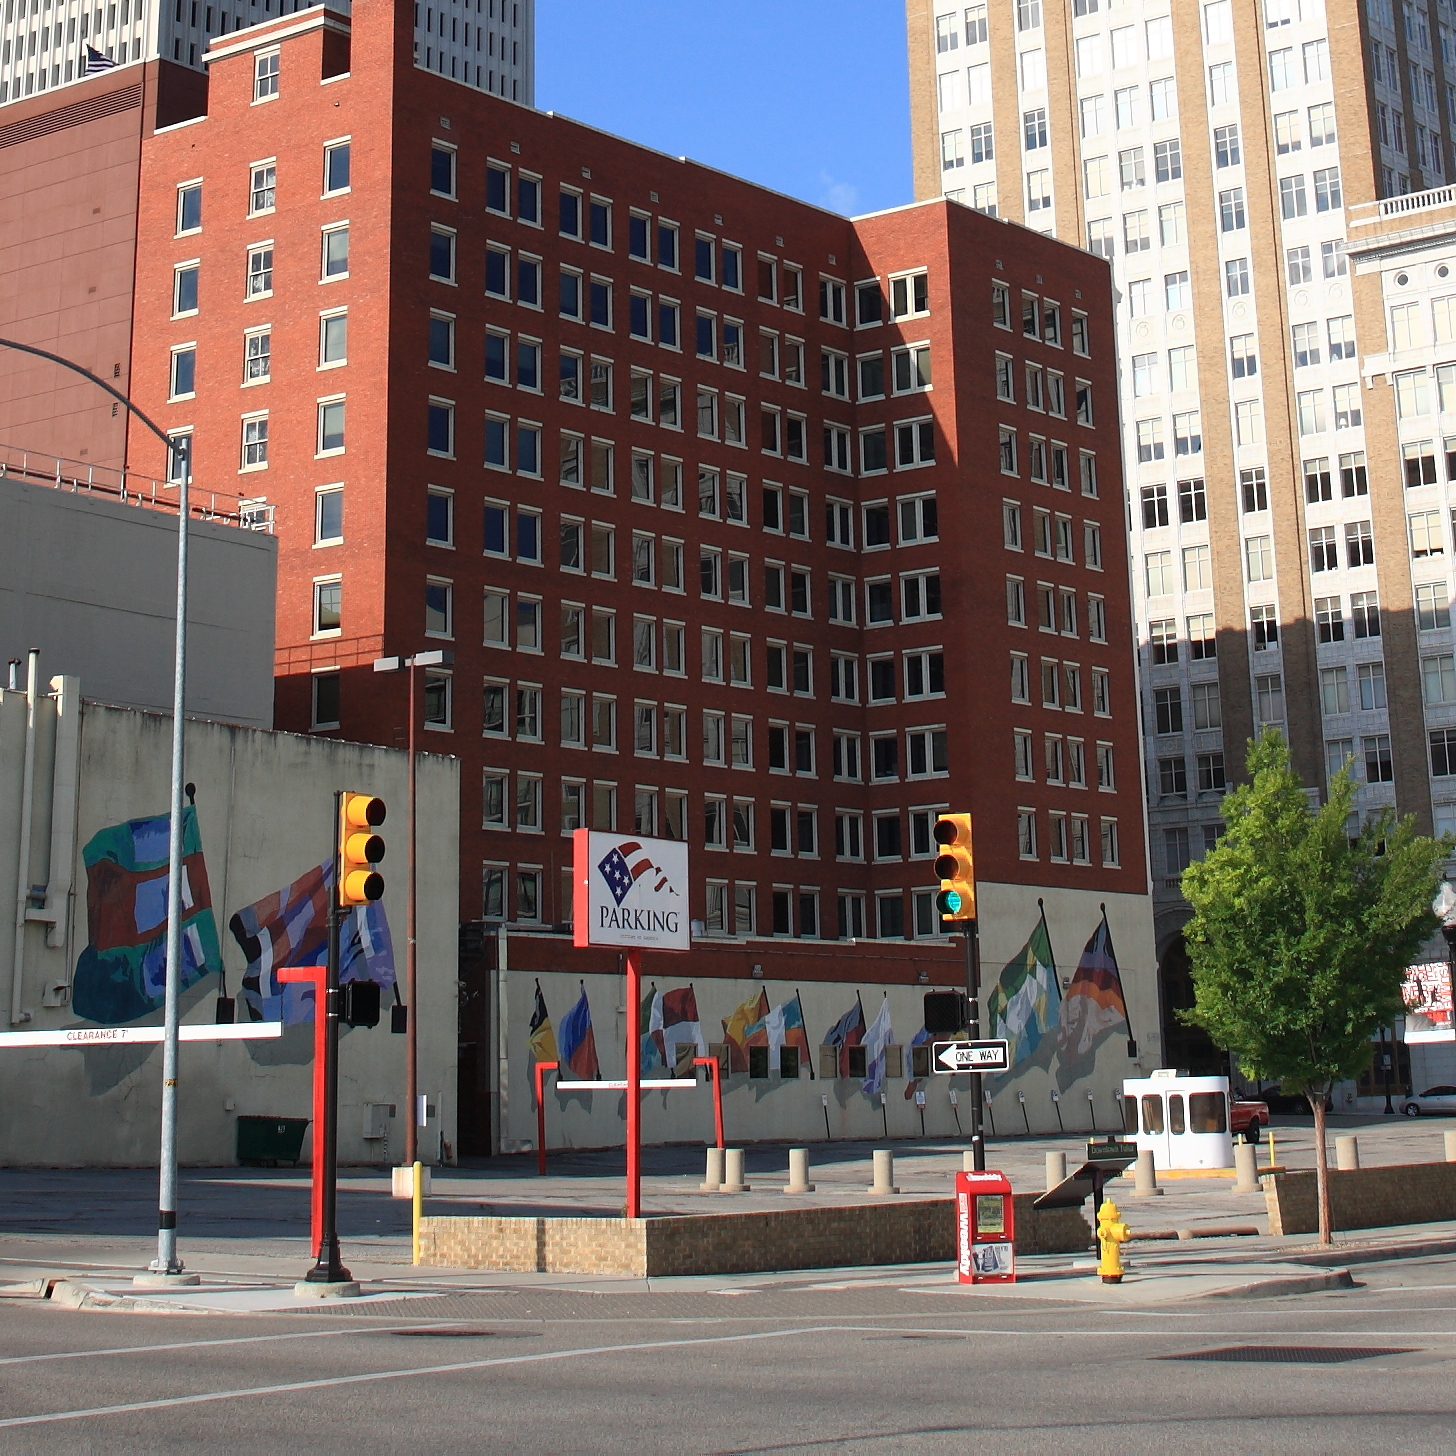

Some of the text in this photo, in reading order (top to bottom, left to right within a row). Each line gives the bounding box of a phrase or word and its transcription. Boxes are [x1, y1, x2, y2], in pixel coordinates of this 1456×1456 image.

[599, 905, 679, 933] PARKING
[67, 1029, 117, 1040] CLEARANCE
[955, 1049, 999, 1062] ONE WAY
[1091, 1144, 1119, 1154] Downtown
